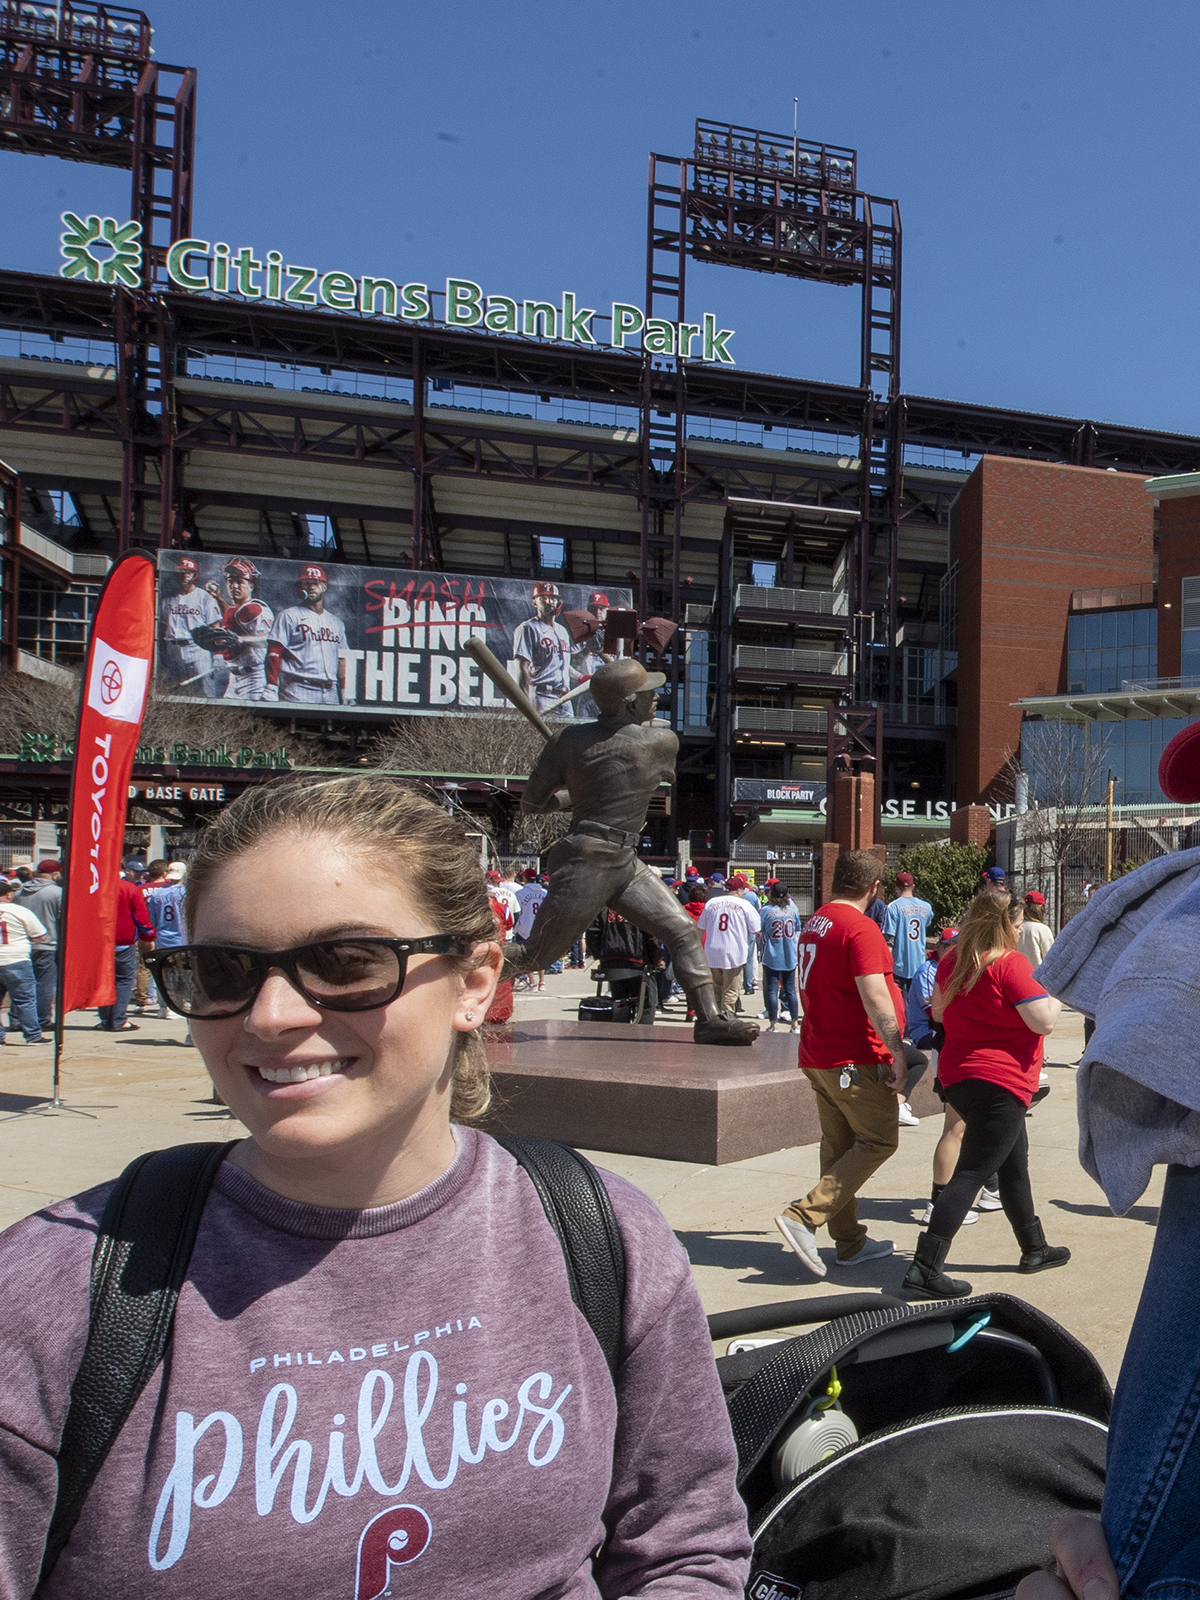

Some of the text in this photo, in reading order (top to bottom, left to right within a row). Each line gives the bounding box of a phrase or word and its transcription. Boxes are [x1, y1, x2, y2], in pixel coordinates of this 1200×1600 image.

[166, 238, 736, 365] Citizens Bank Park
[365, 580, 485, 611] SMASH
[382, 597, 487, 651] RING
[341, 649, 421, 703] THE
[172, 743, 232, 764] Bank
[239, 746, 292, 767] Park
[146, 786, 182, 800] BASE
[189, 787, 226, 801] GATE
[767, 789, 814, 800] BLOCK PARTY
[89, 733, 112, 895] TOYOTA
[164, 905, 175, 922] 8
[718, 912, 729, 932] 8
[771, 919, 794, 939] 20
[908, 918, 920, 941] 3
[798, 942, 817, 991] 17
[249, 1315, 484, 1374] PHILADELPHIA
[148, 1350, 573, 1571] phillies
